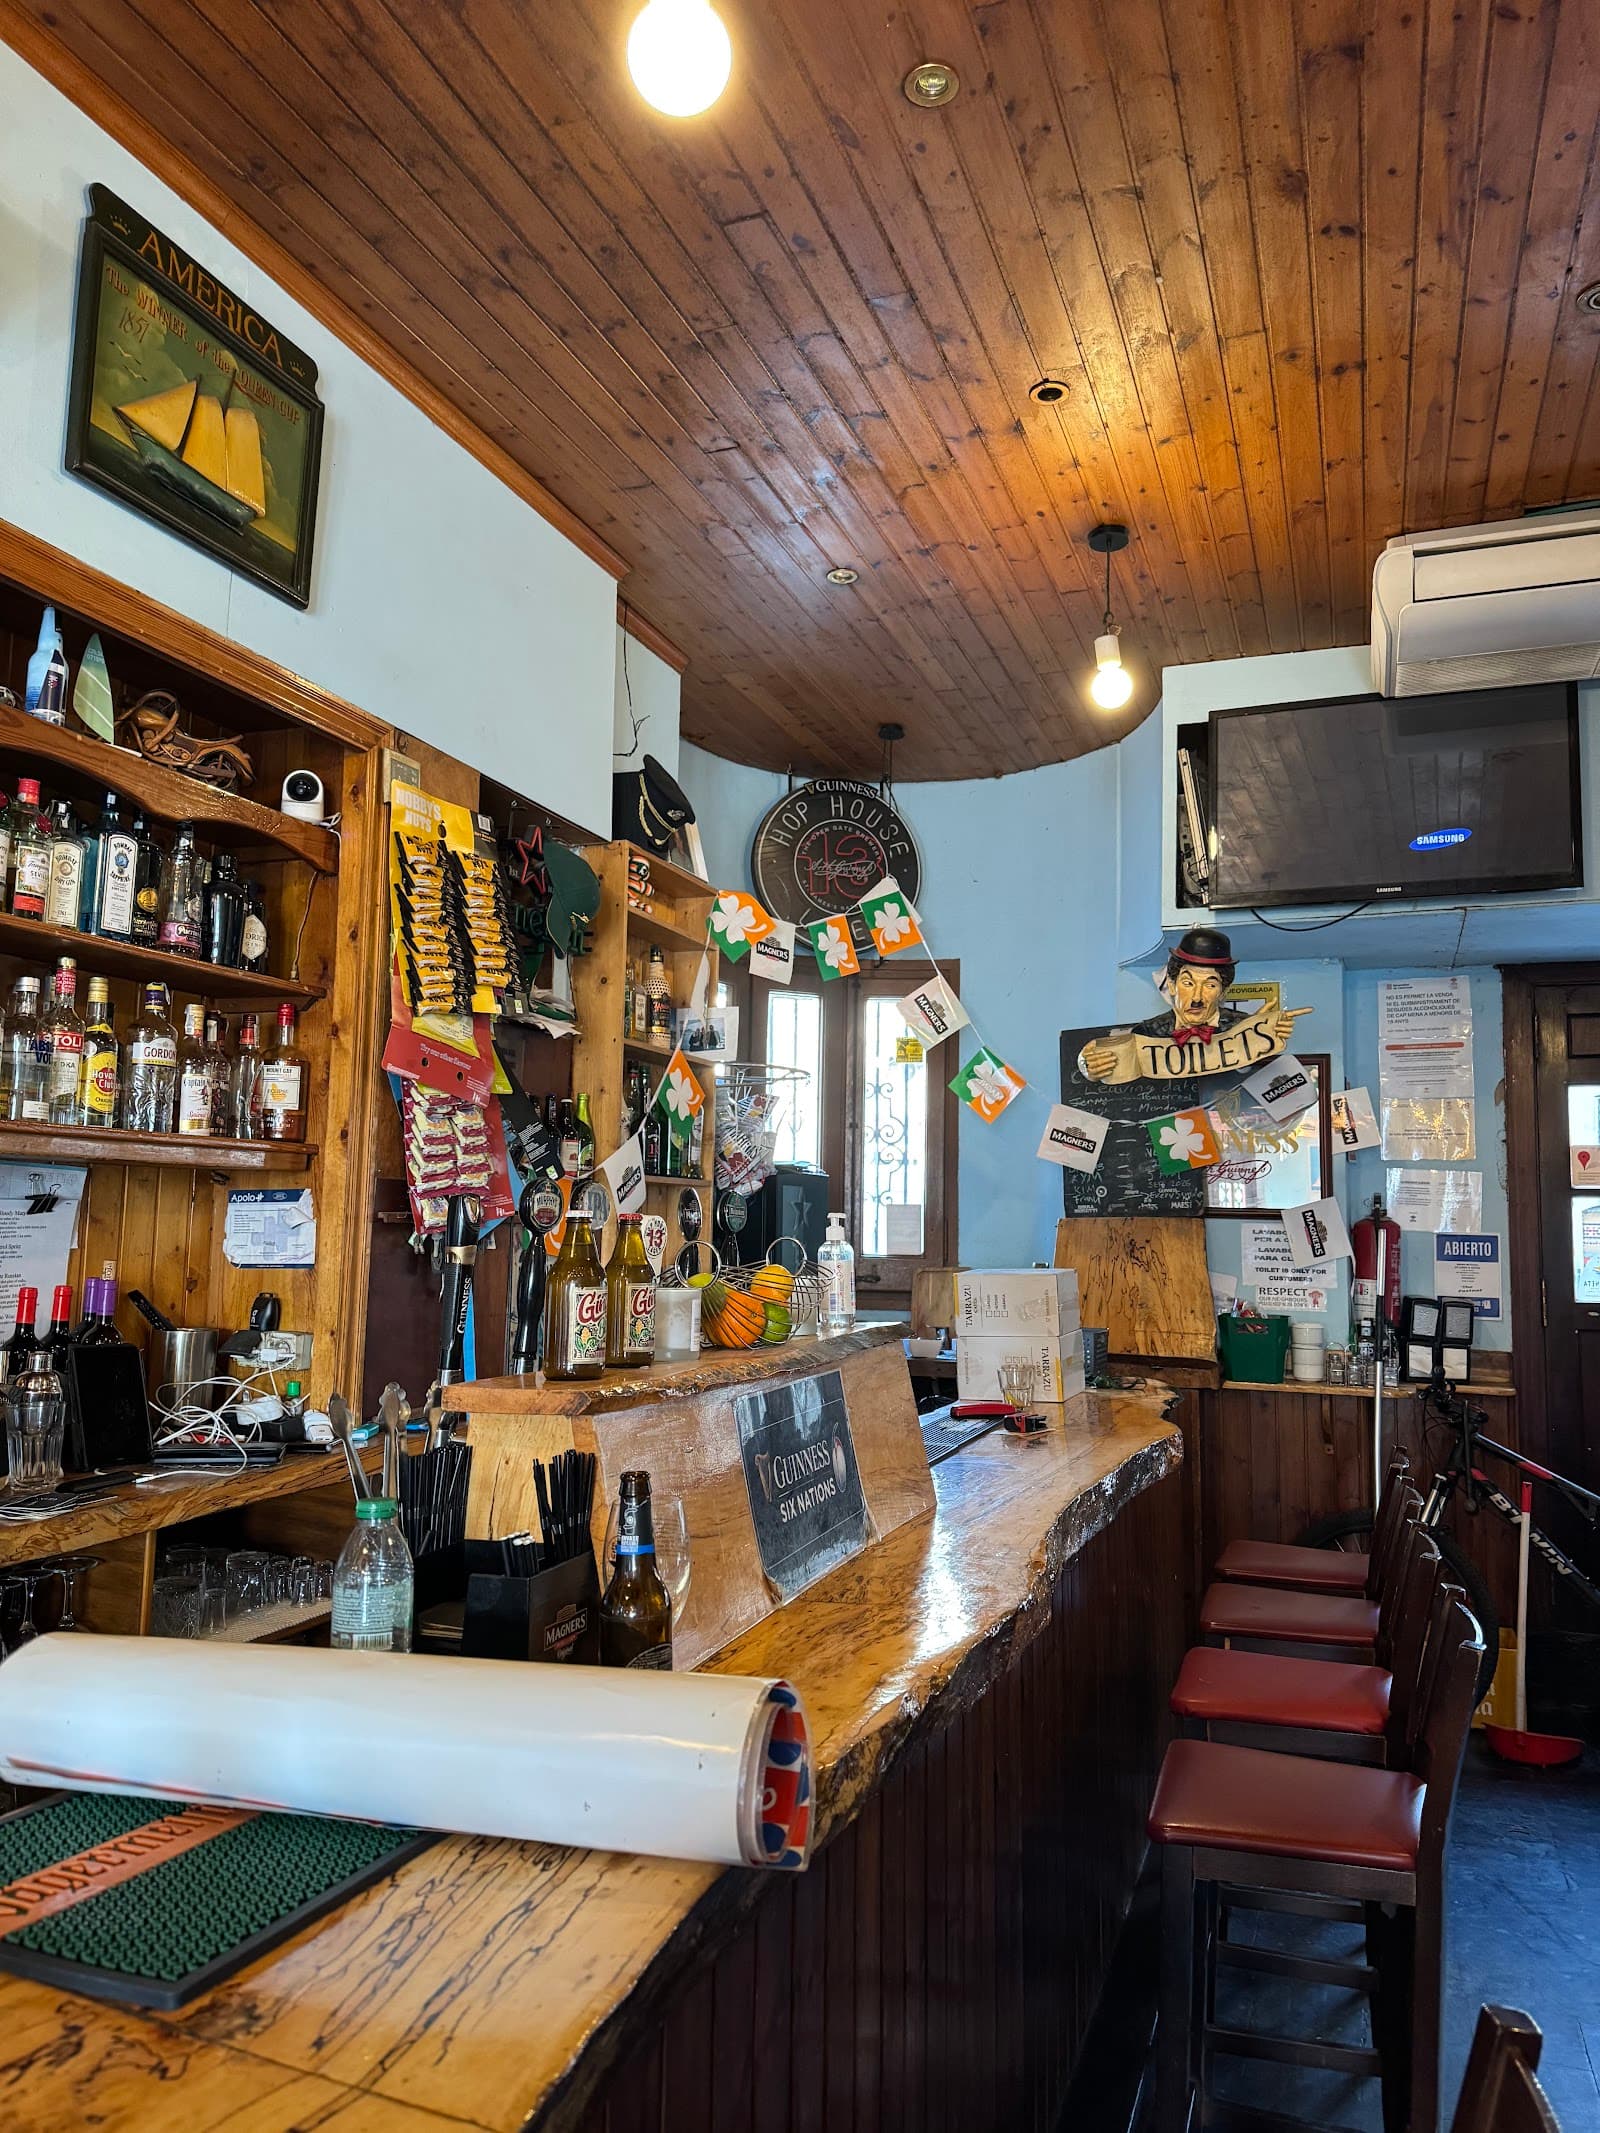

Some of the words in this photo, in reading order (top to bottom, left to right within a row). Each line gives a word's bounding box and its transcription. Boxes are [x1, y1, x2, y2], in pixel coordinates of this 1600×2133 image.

[138, 231, 282, 368] AMERICA
[106, 267, 129, 296] The
[137, 286, 188, 344] WINNER
[213, 350, 231, 373] the
[816, 780, 876, 799] GUINNESS
[770, 801, 808, 847] HOP
[830, 795, 909, 858] HOUSE
[1416, 833, 1465, 845] SAMSUNG
[757, 943, 789, 960] MAGNERS
[918, 996, 947, 1032] MAGNERS
[1142, 1019, 1275, 1075] TOILETS
[1085, 1084, 1155, 1096] Leaving
[1162, 1080, 1200, 1093] date
[1264, 1075, 1304, 1102] MAGNERS
[1051, 1130, 1094, 1151] MAGNERS
[618, 1168, 642, 1202] MAGNERS
[647, 1229, 664, 1248] 13
[1304, 1211, 1324, 1256] MAGNERS
[1443, 1241, 1492, 1257] ABIERTO
[456, 1277, 472, 1335] GUINNESS
[1258, 1287, 1308, 1296] RESPECT
[1041, 1347, 1052, 1392] TARRAZU
[773, 1440, 831, 1489] GUINNESS
[780, 1500, 798, 1524] SIX
[797, 1478, 837, 1513] NATIONS
[546, 1613, 587, 1645] MAGNERS
